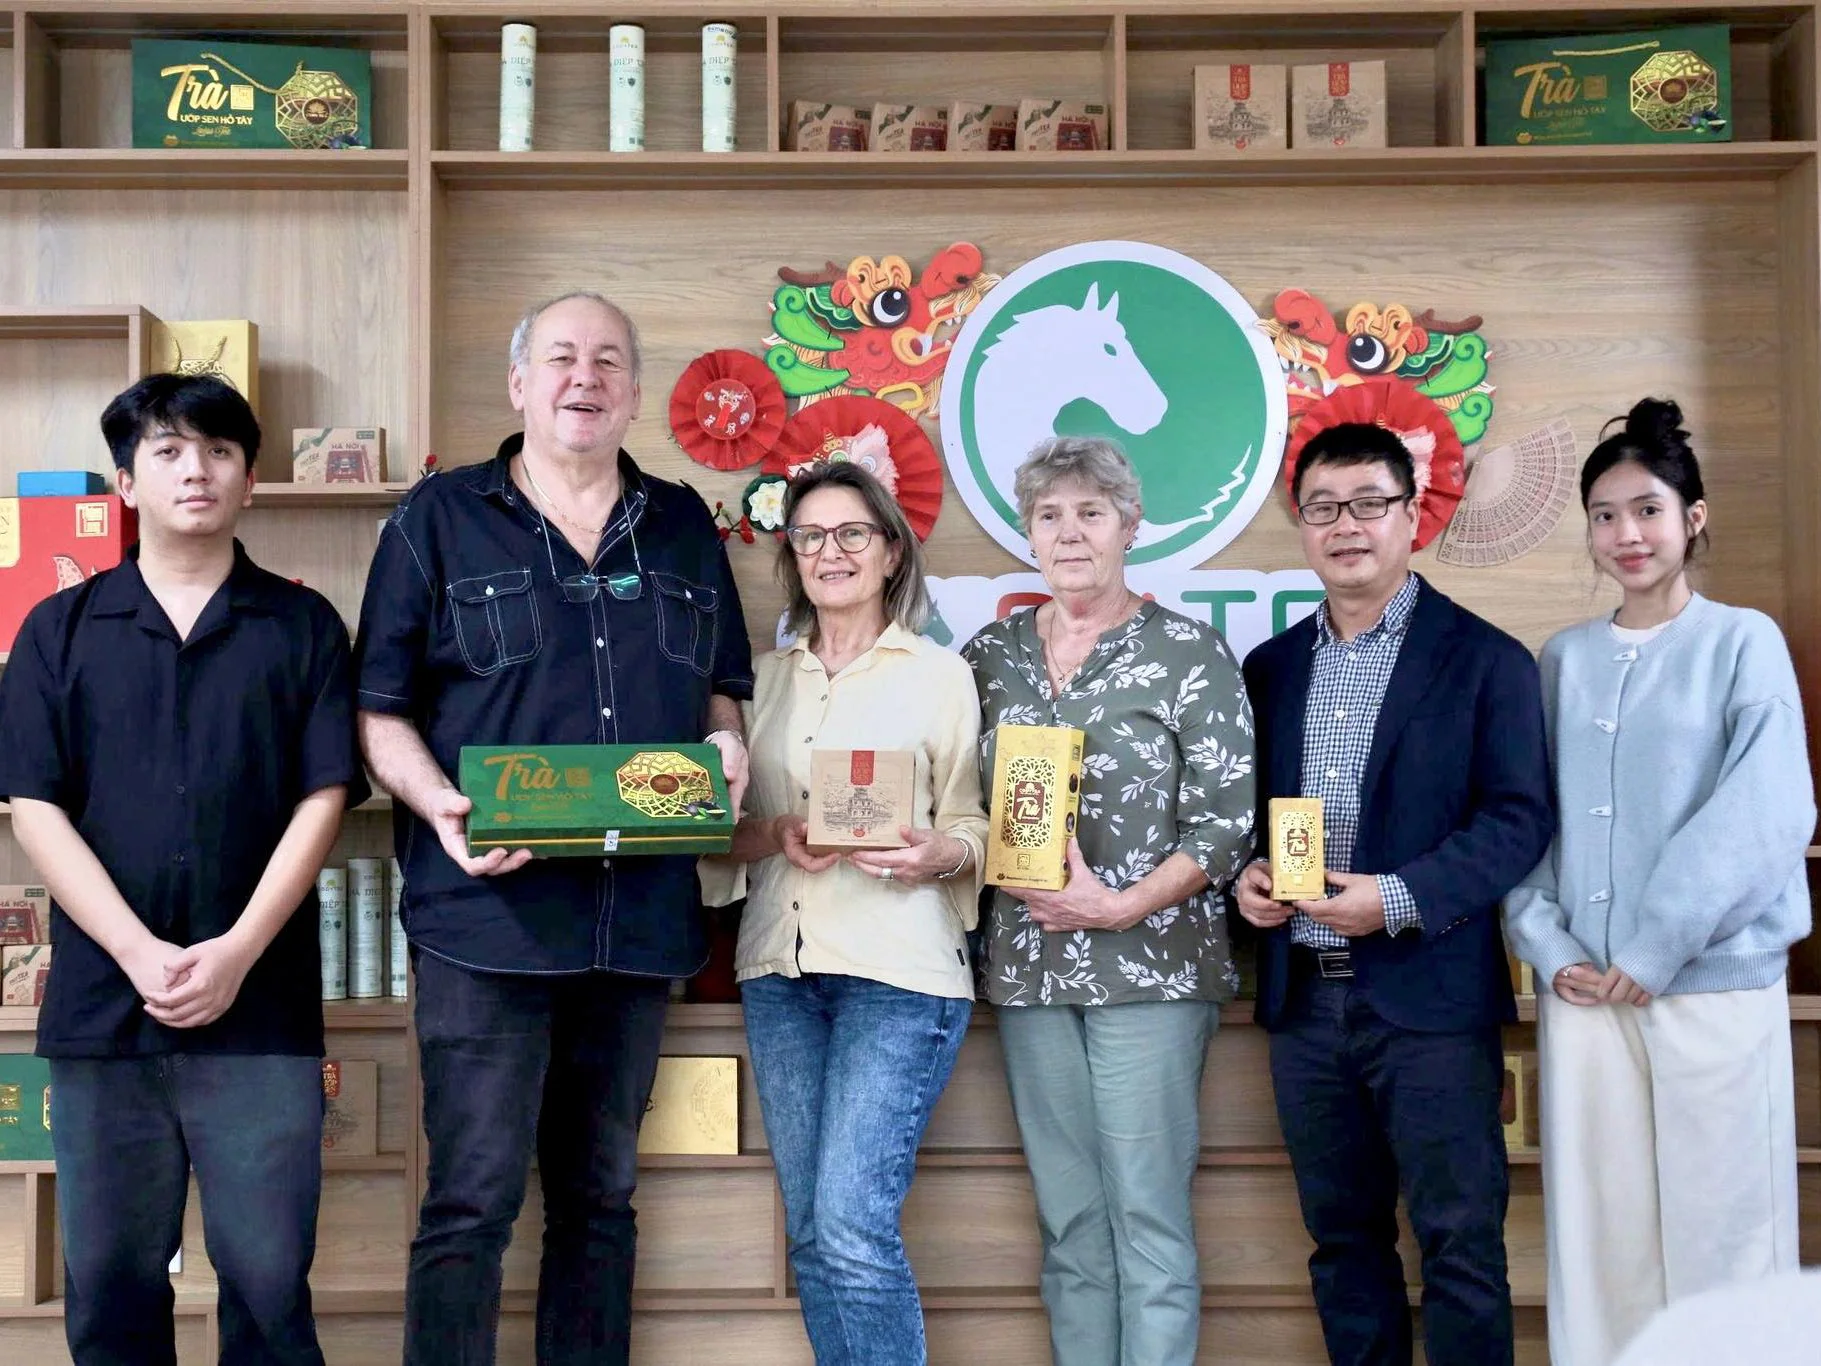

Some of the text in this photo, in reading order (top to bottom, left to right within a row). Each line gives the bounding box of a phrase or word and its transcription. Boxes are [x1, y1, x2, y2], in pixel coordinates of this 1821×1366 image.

[161, 64, 228, 121] Trà
[1514, 61, 1581, 119] Trà
[201, 115, 219, 124] SEN
[484, 753, 562, 800] Trà
